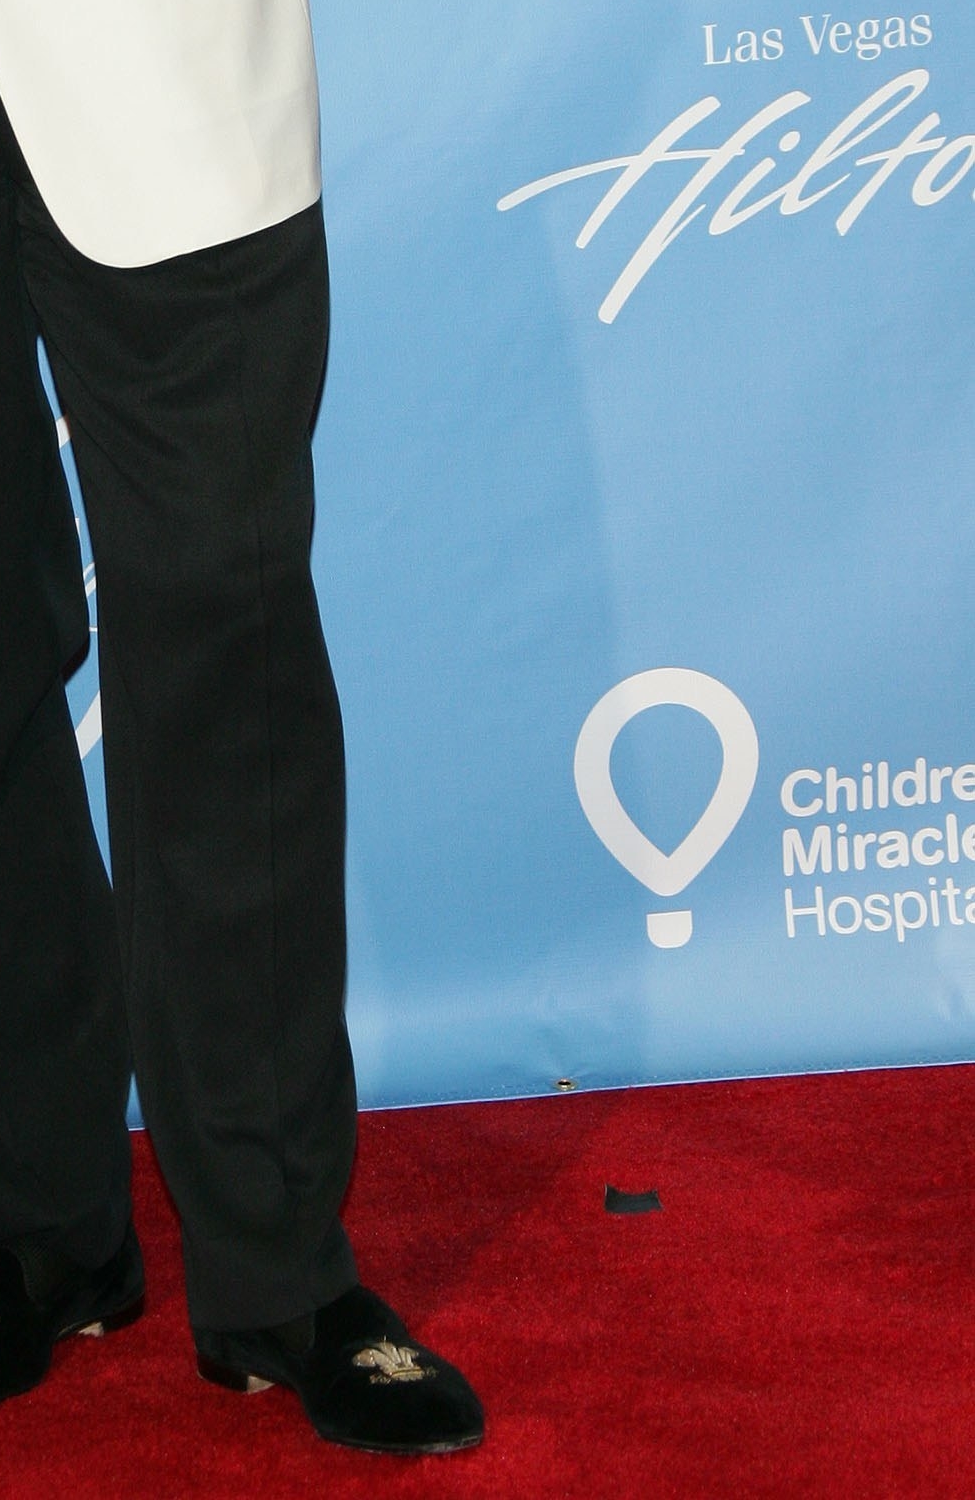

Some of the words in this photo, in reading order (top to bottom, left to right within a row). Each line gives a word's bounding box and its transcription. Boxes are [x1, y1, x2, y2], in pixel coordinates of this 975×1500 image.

[702, 22, 785, 66] Las
[800, 13, 933, 62] Vegas
[496, 68, 975, 325] Hilto
